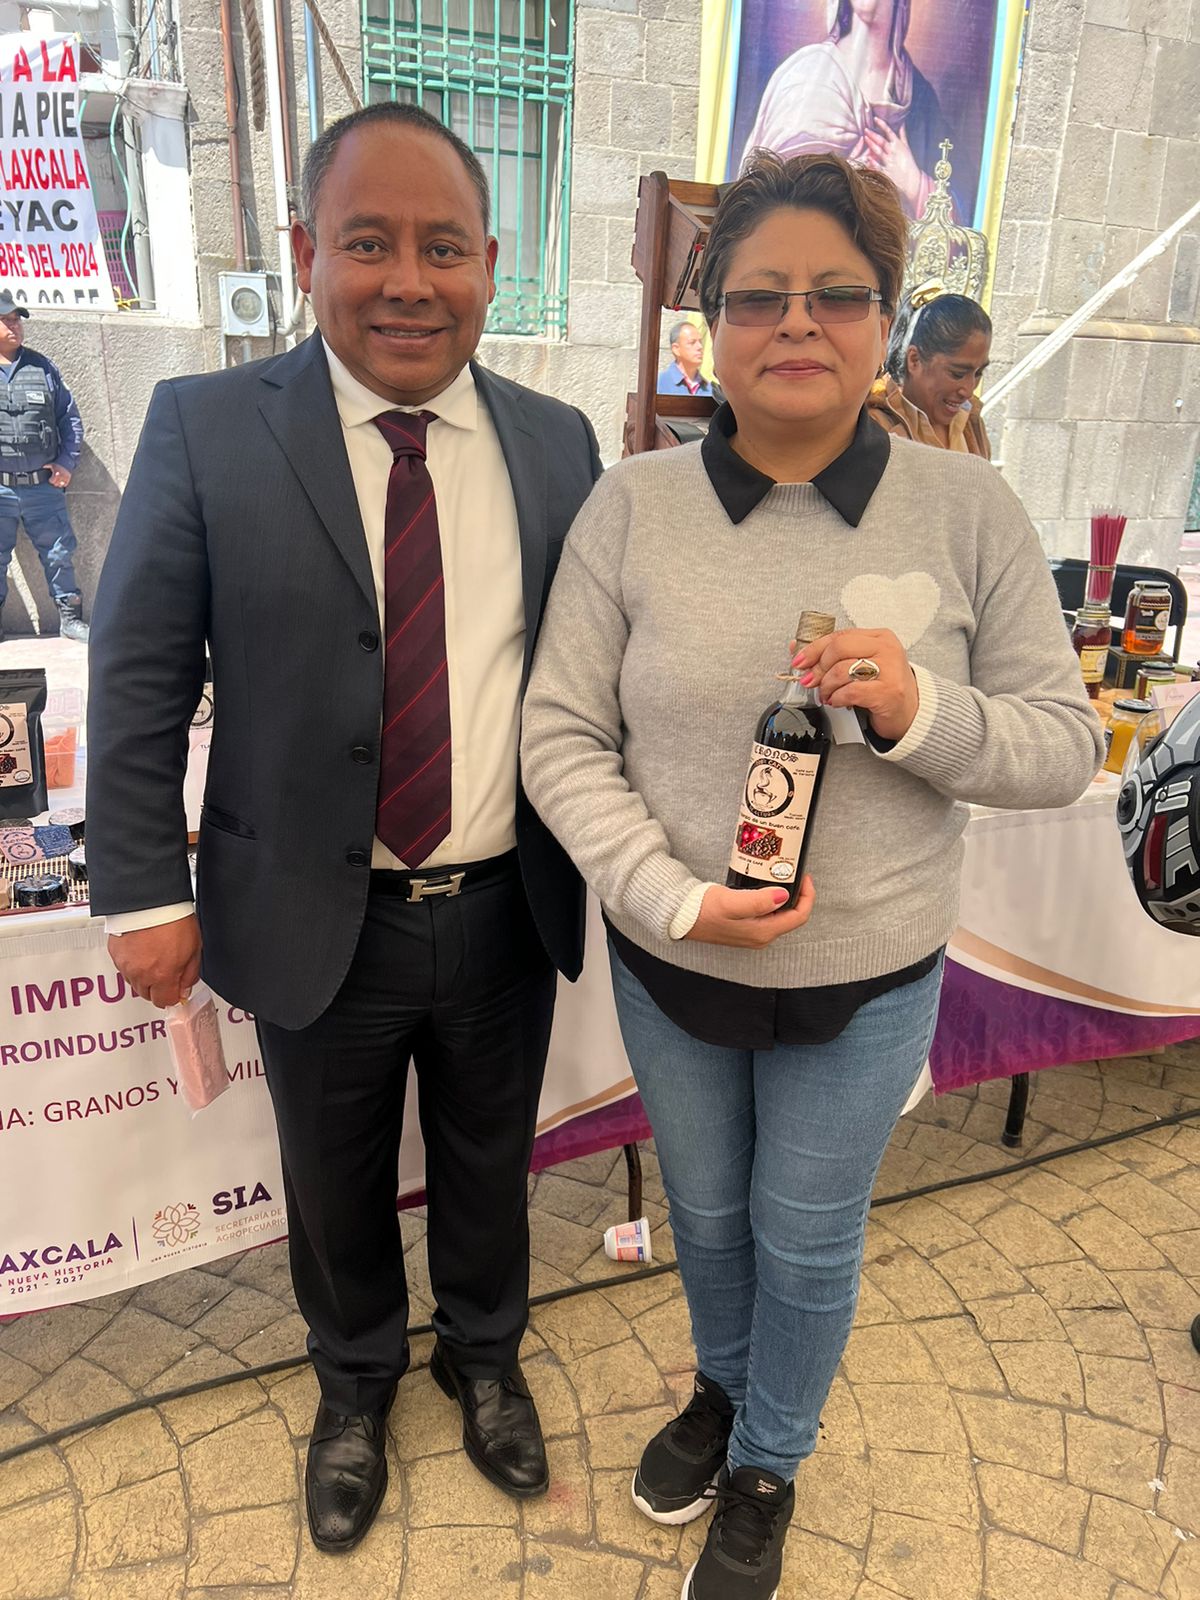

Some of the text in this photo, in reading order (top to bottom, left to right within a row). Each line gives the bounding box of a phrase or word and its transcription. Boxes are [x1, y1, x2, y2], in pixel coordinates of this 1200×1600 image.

[13, 40, 77, 82] A LA
[12, 92, 78, 137] A PIE
[27, 242, 61, 278] DEL
[61, 241, 99, 278] 2024
[43, 1081, 161, 1123] GRANOS
[166, 1077, 179, 1095] Y
[212, 1181, 273, 1216] SIA
[270, 1207, 283, 1219] DE
[0, 1232, 124, 1275] AXCALA
[8, 1257, 114, 1287] NUEVA HISTORIA
[10, 1283, 39, 1295] 2021
[55, 1273, 85, 1285] 2027
